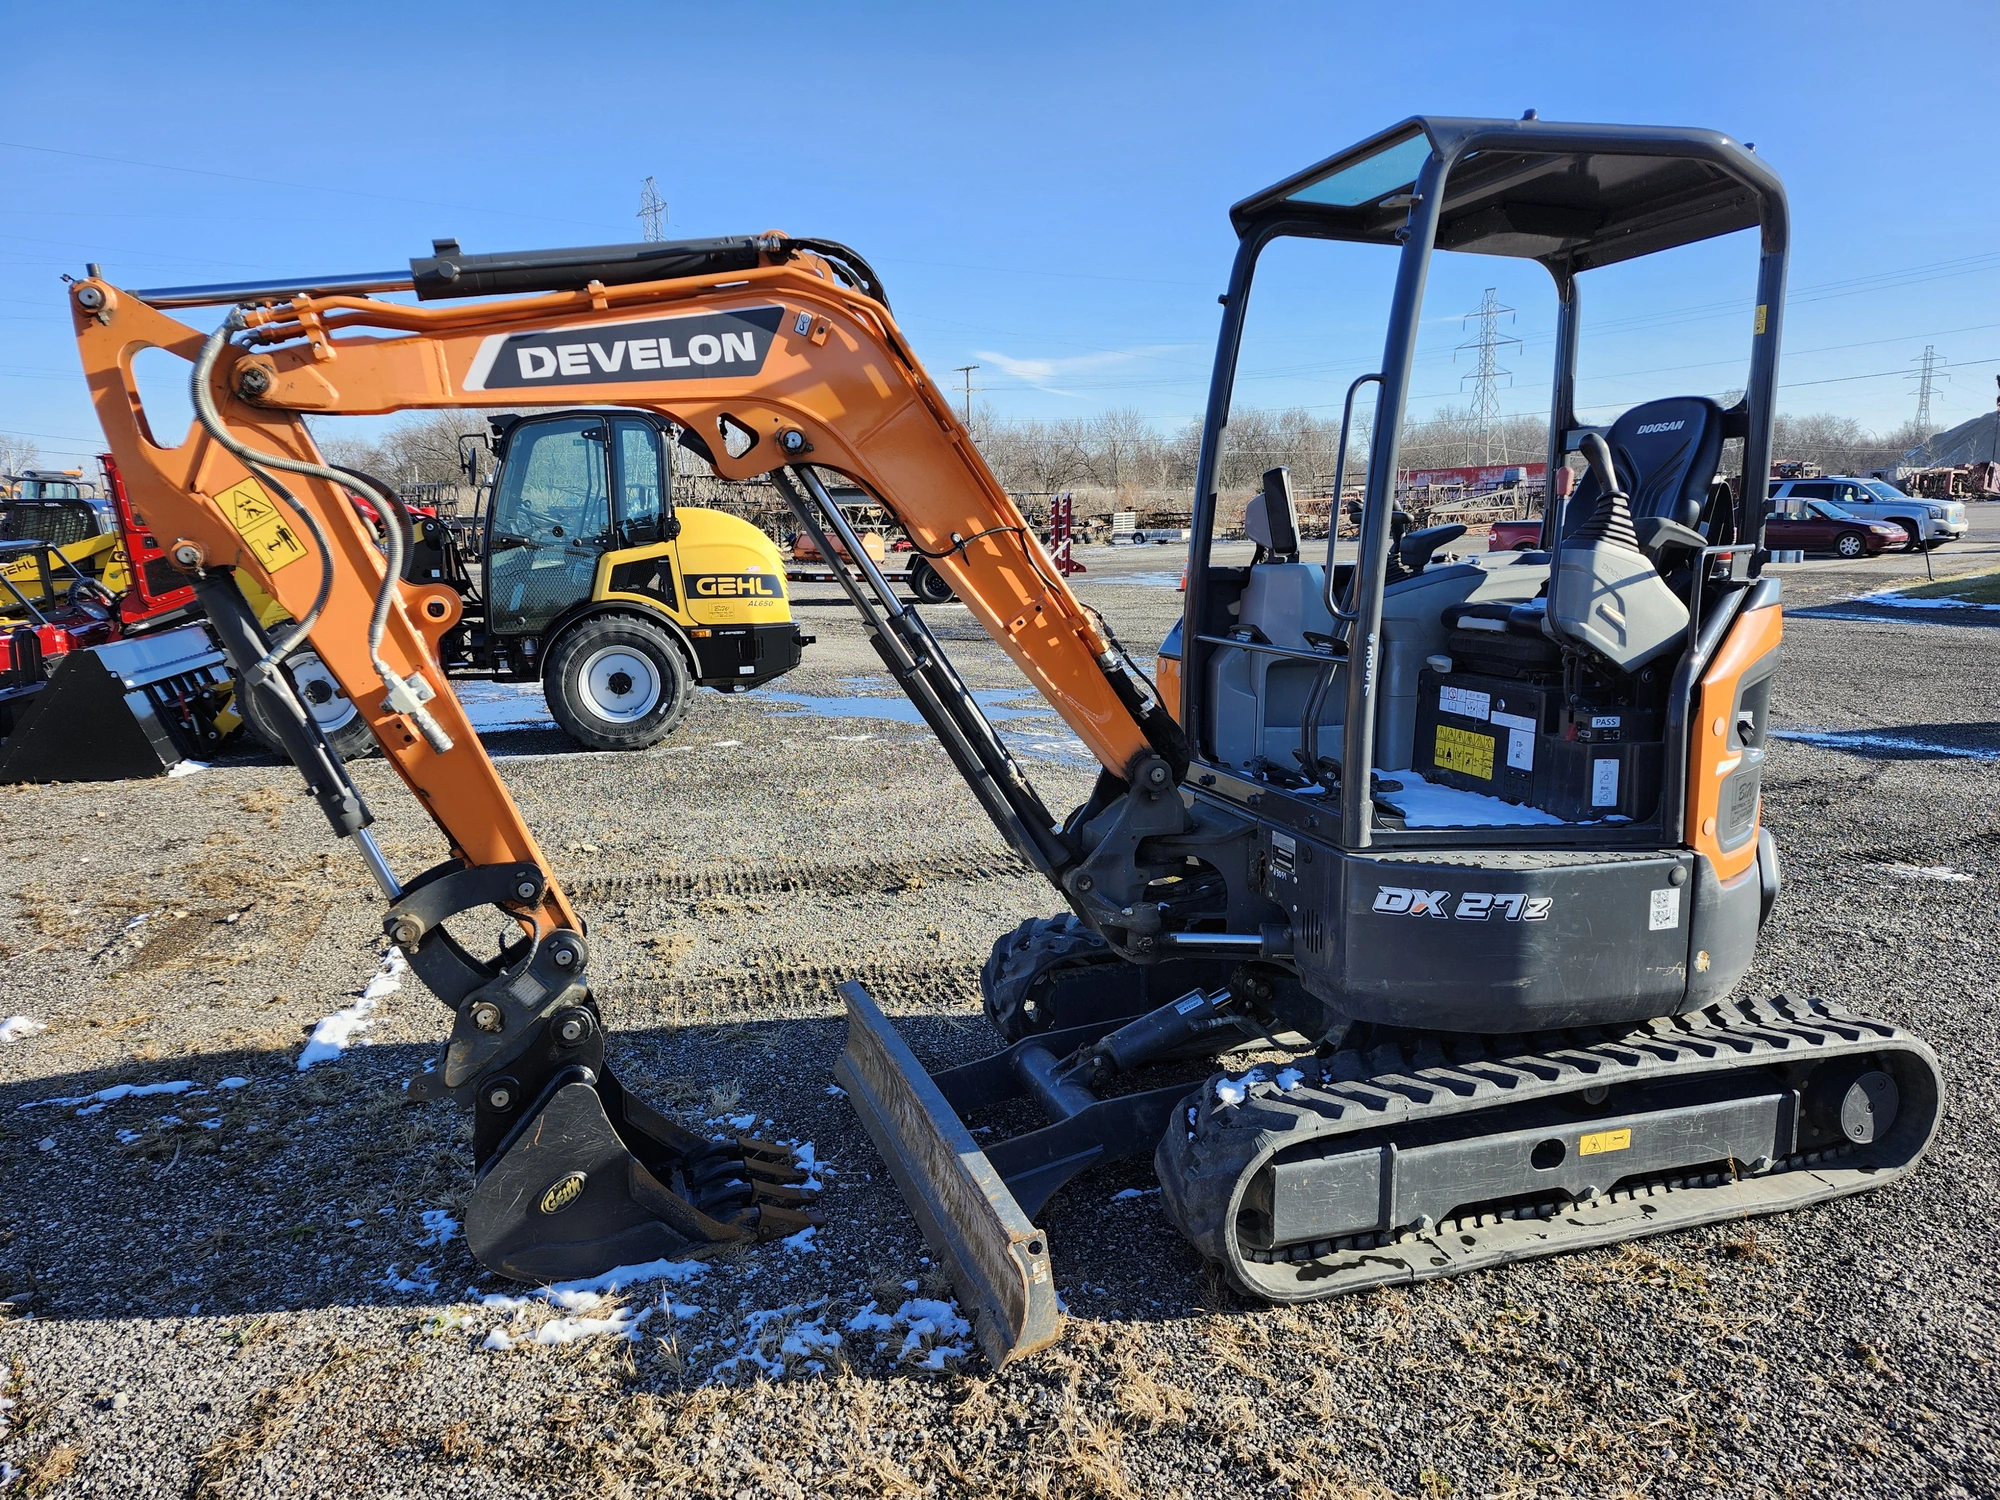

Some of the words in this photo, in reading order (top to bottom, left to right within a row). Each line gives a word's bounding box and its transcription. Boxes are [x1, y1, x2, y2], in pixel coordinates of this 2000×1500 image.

[516, 331, 757, 380] DEVELON
[1636, 419, 1686, 435] DOOSAN
[696, 577, 773, 595] GEHL
[1363, 632, 1377, 697] #3057
[1595, 718, 1617, 726] PASS
[1372, 886, 1451, 919] DX
